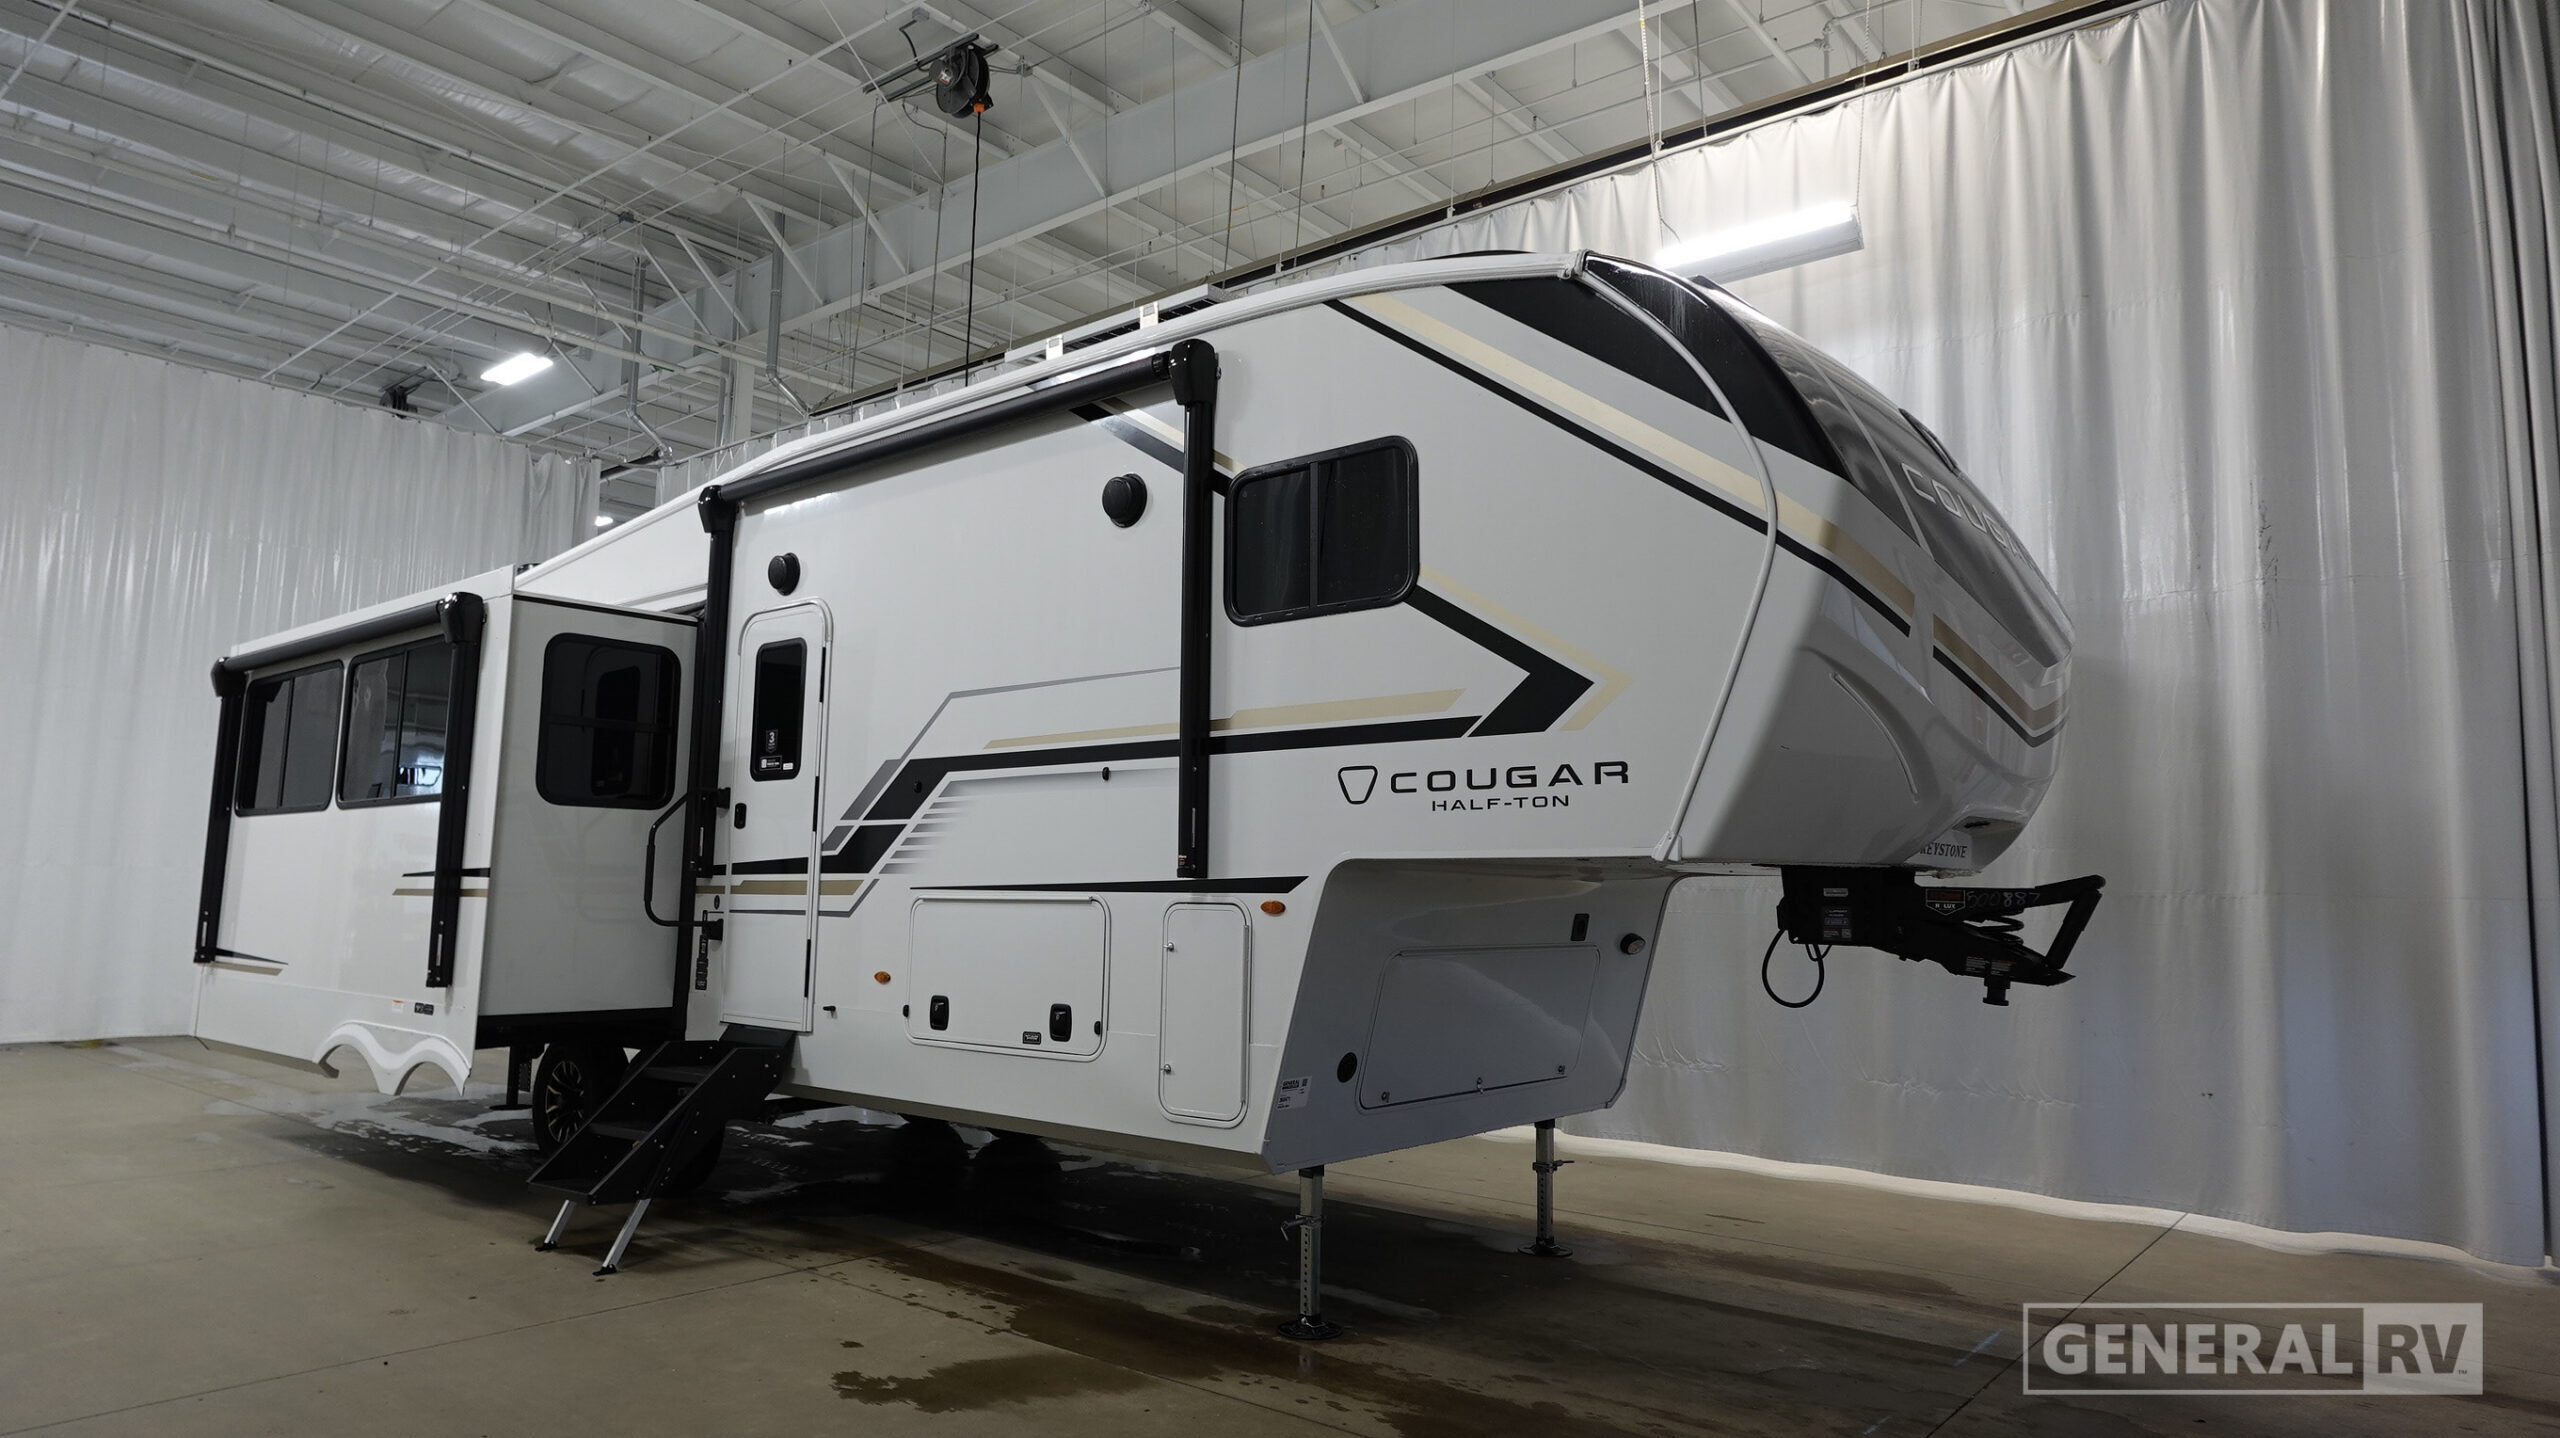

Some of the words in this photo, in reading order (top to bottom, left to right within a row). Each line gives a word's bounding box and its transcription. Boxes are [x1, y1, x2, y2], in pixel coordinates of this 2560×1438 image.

[1901, 462, 2034, 571] COUG
[1390, 761, 1630, 794] COUGAR
[1431, 794, 1570, 812] HALF-TON
